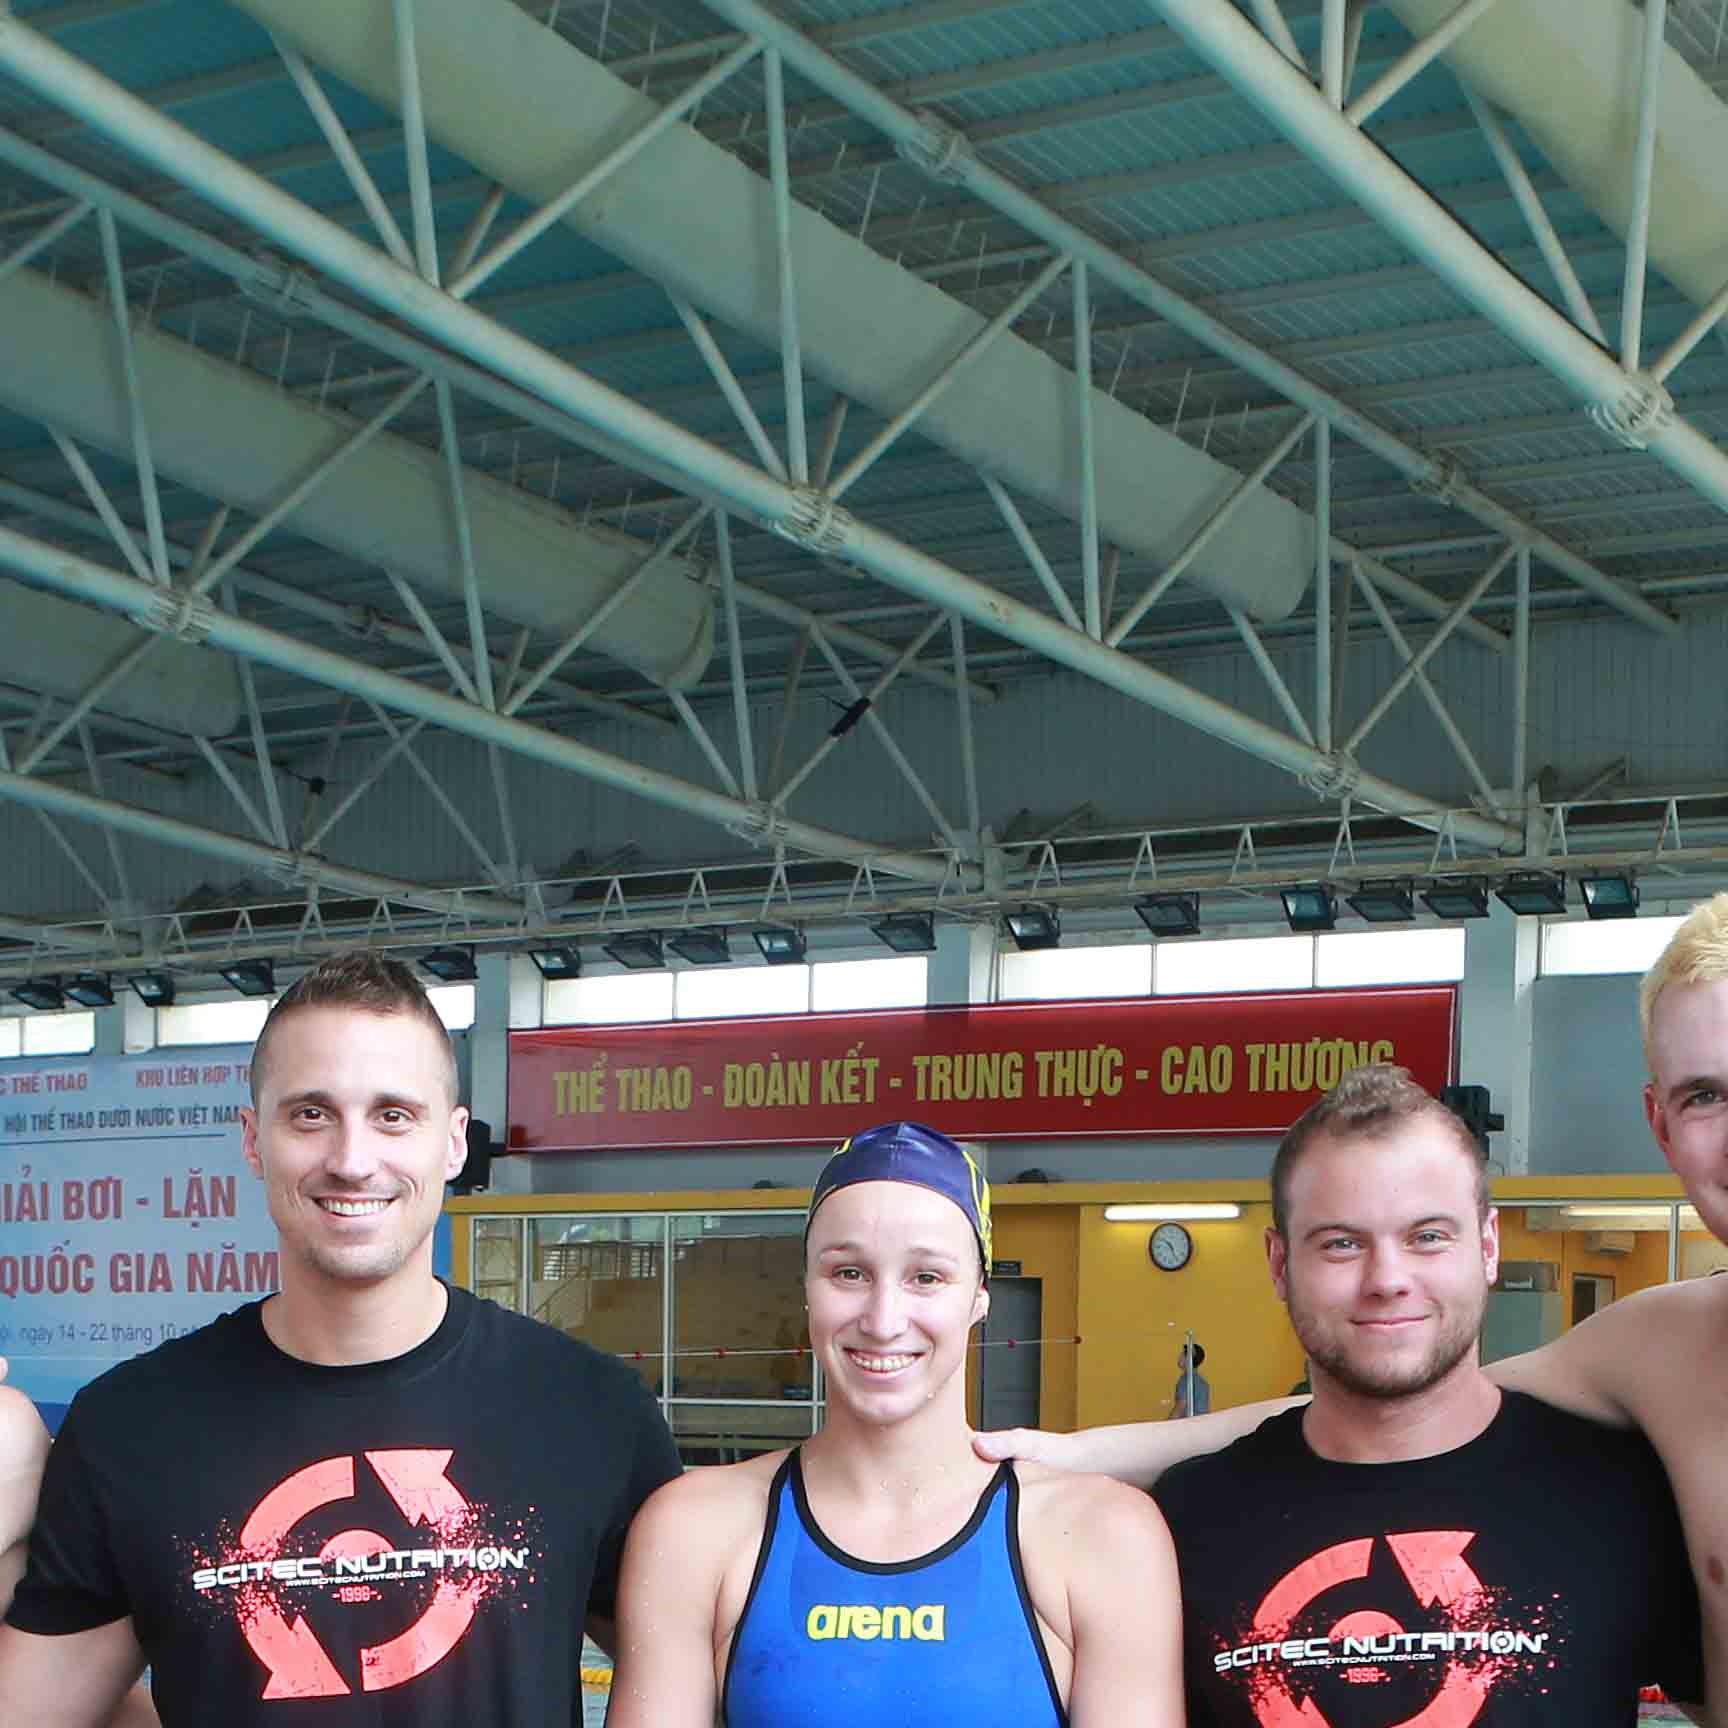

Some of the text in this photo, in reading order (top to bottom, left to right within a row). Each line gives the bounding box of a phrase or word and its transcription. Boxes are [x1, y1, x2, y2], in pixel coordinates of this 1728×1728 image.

[553, 1052, 608, 1115] THỂ
[616, 1066, 693, 1112] THAO
[701, 1085, 714, 1095] -
[724, 1052, 811, 1108] ĐOÀN
[820, 1041, 880, 1105] KẾT
[888, 1078, 902, 1088] -
[912, 1051, 1024, 1101] TRUNG
[1035, 1043, 1124, 1106] THỰC
[1135, 1070, 1149, 1079] -
[1161, 1045, 1234, 1095] CAO
[60, 1108, 94, 1130] THAO
[63, 1176, 123, 1221] BƠI
[162, 1168, 236, 1228] LẶN
[109, 1252, 172, 1294] GIA
[186, 1242, 279, 1293] NĂM
[88, 1323, 109, 1342] 22
[111, 1323, 153, 1346] tháng
[192, 1558, 322, 1590] SCITEC
[808, 1604, 944, 1641] arena
[1213, 1637, 1330, 1672] SCITEC
